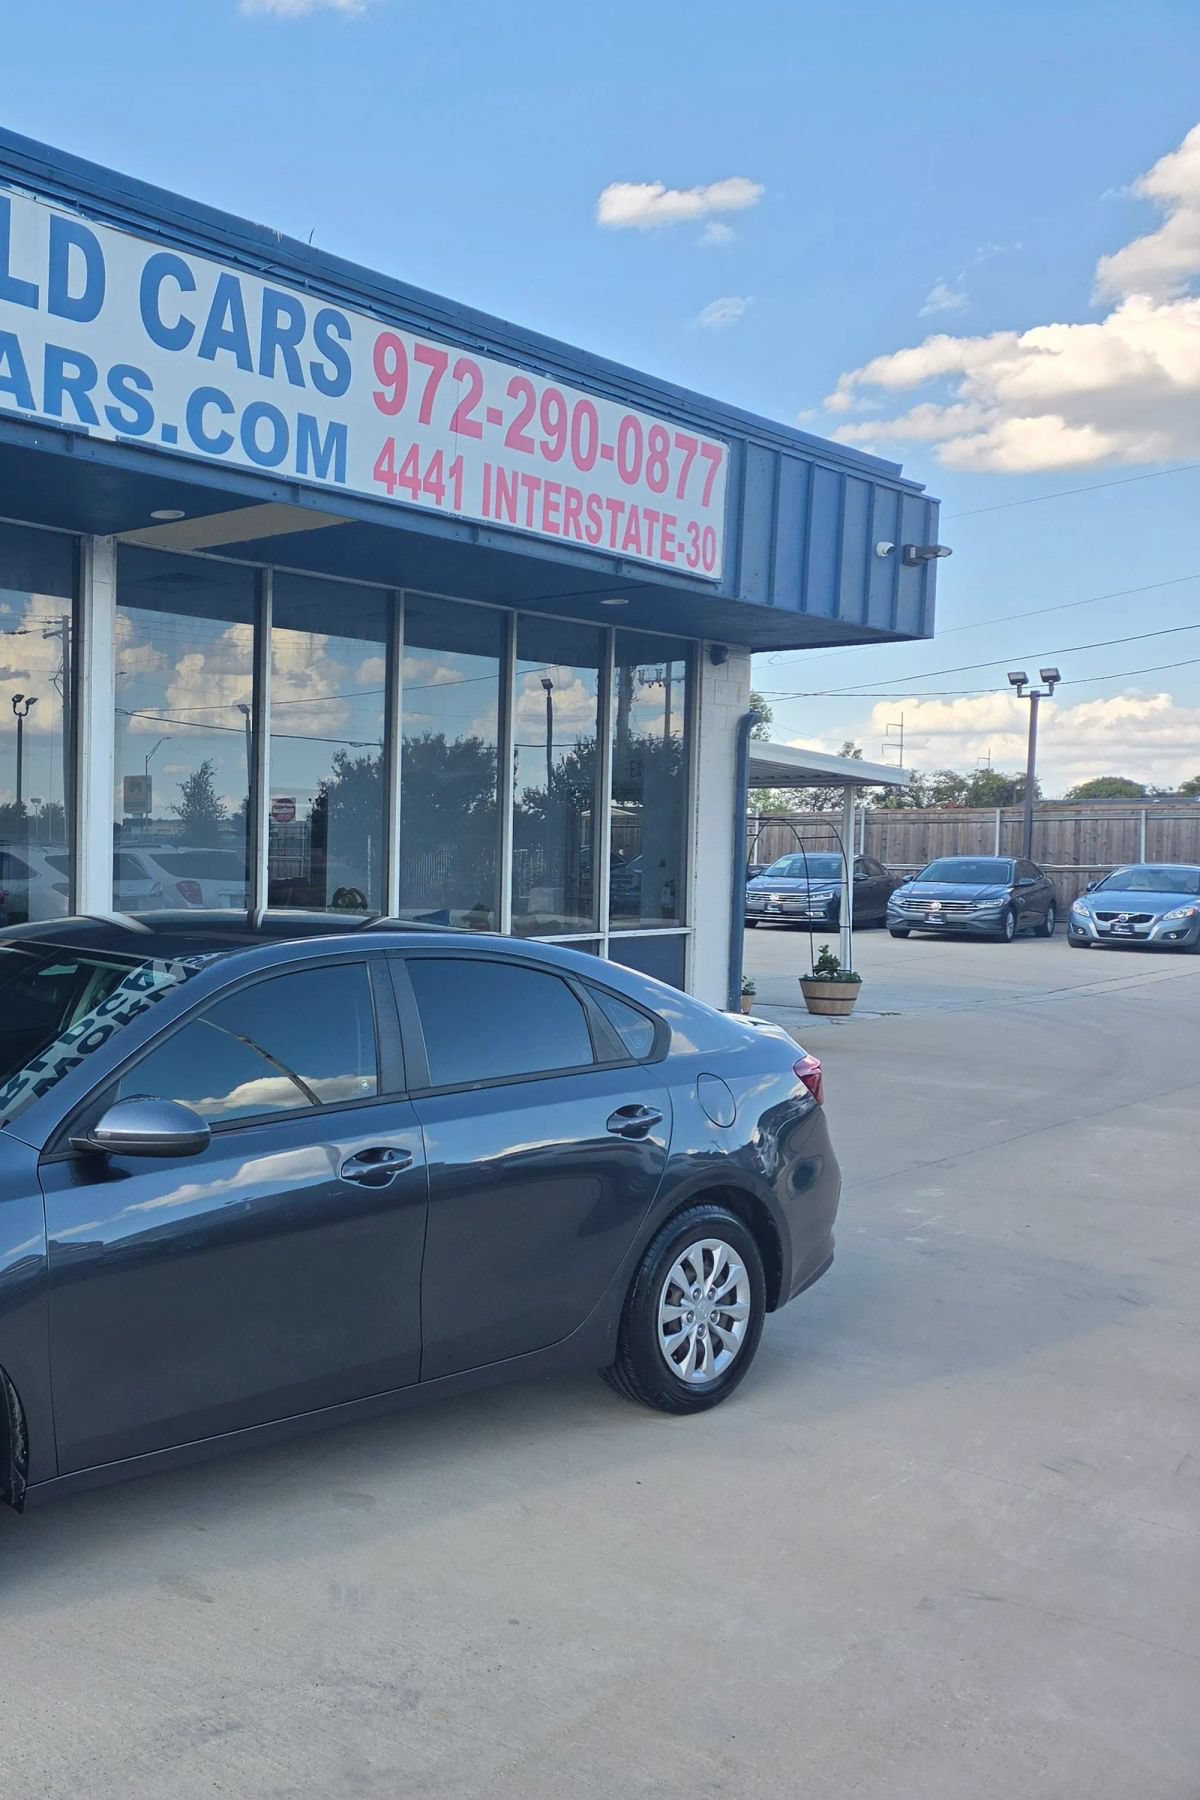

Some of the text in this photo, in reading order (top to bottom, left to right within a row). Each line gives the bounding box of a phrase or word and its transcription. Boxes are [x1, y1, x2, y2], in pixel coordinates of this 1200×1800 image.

[139, 252, 352, 398] CARS
[373, 332, 723, 507] 972-290-0877
[373, 437, 717, 572] 4441 INTERSTATE-30
